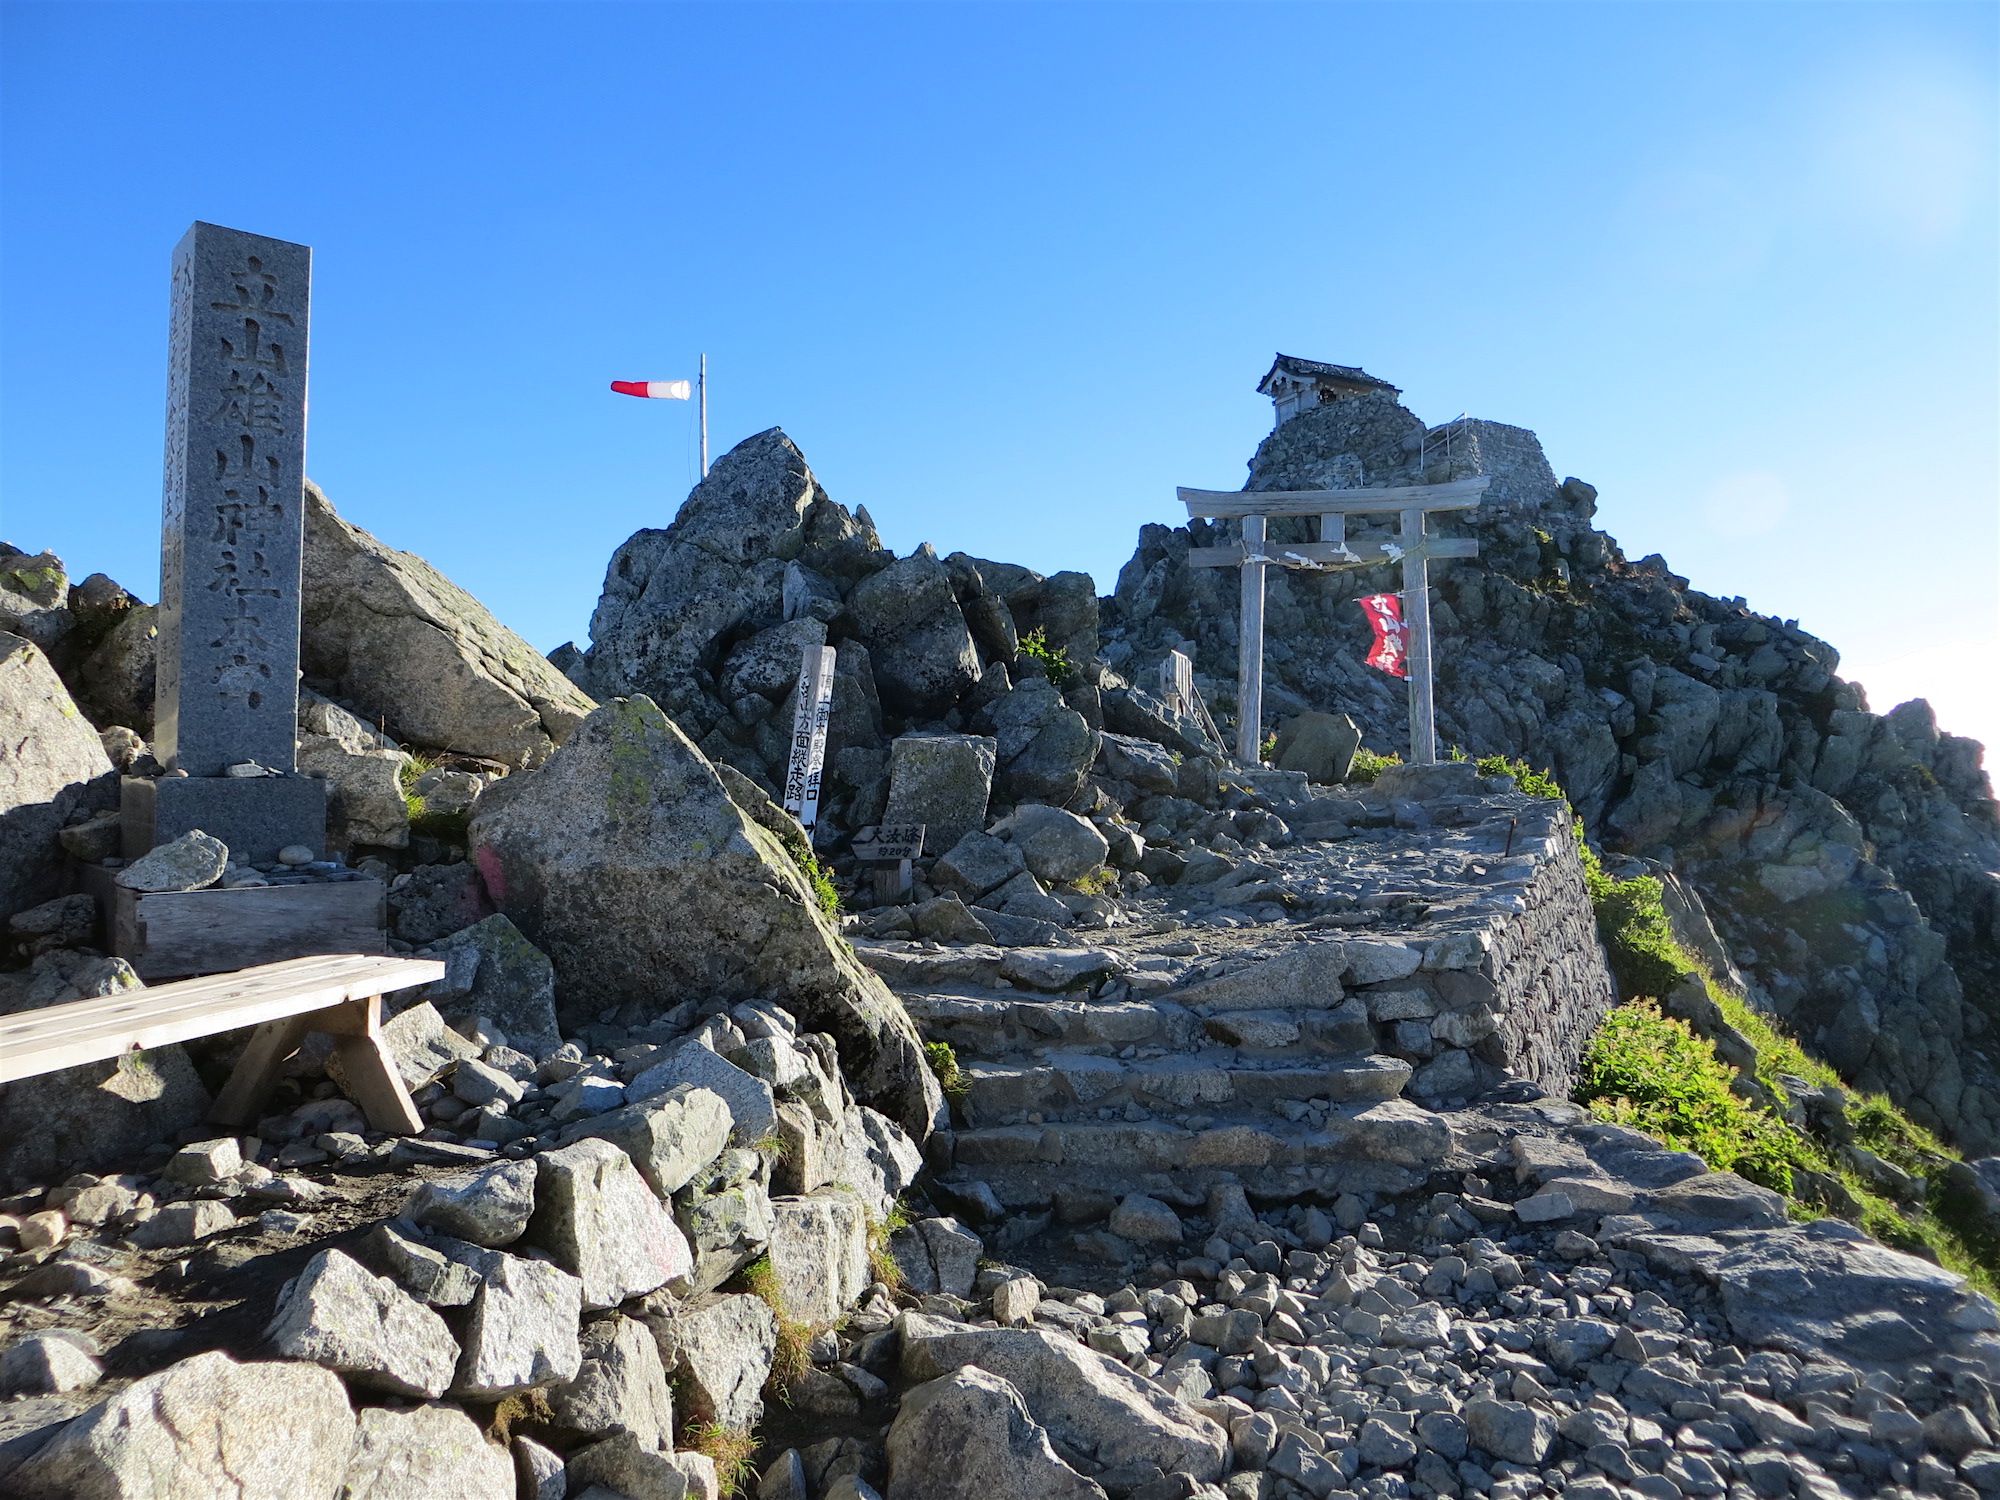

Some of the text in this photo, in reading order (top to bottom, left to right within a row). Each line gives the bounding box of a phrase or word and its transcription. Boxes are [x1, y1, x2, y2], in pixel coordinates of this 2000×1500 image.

[869, 827, 922, 844] 大汝峰
[877, 846, 912, 858] 約20分
